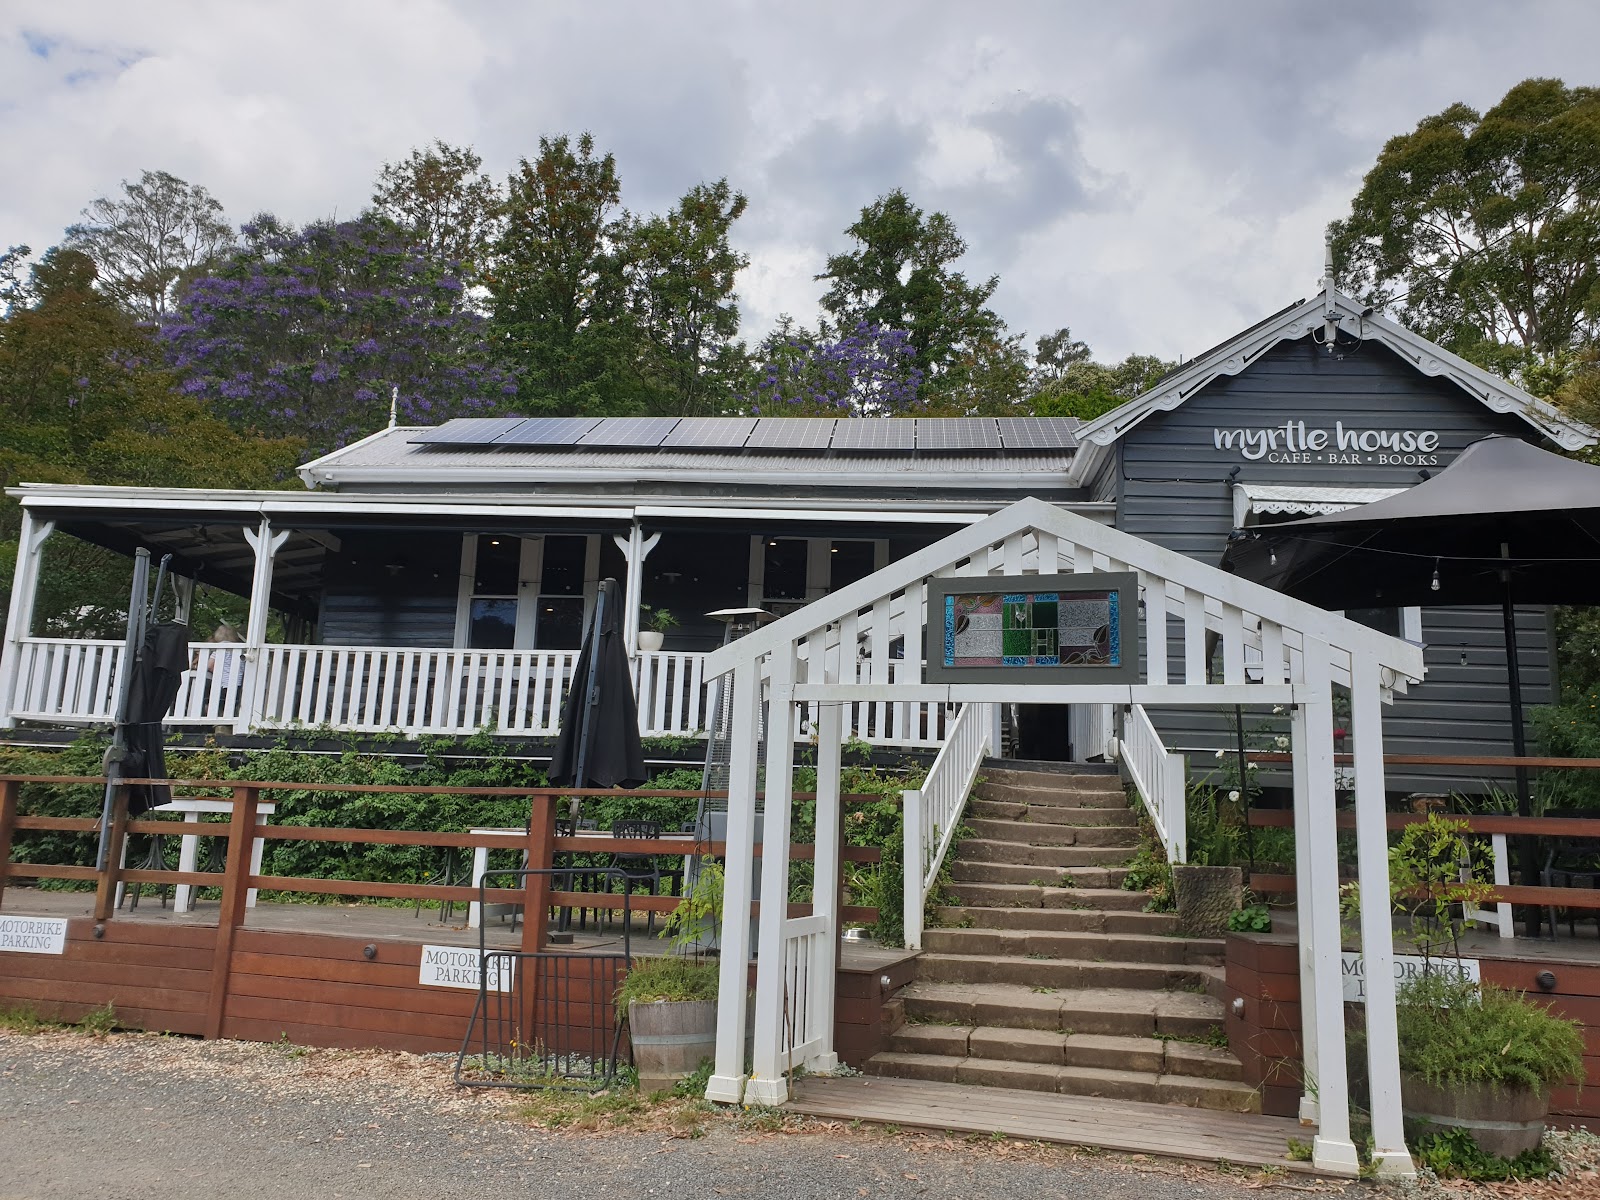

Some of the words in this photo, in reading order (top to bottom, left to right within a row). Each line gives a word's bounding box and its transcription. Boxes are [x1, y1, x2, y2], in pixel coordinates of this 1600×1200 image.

[1213, 420, 1328, 460] myrtle
[1335, 420, 1440, 453] house
[1268, 452, 1312, 464] CAFE
[1328, 453, 1362, 465] BAR
[1378, 454, 1438, 466] BOOKS
[1, 934, 51, 949] PARKING
